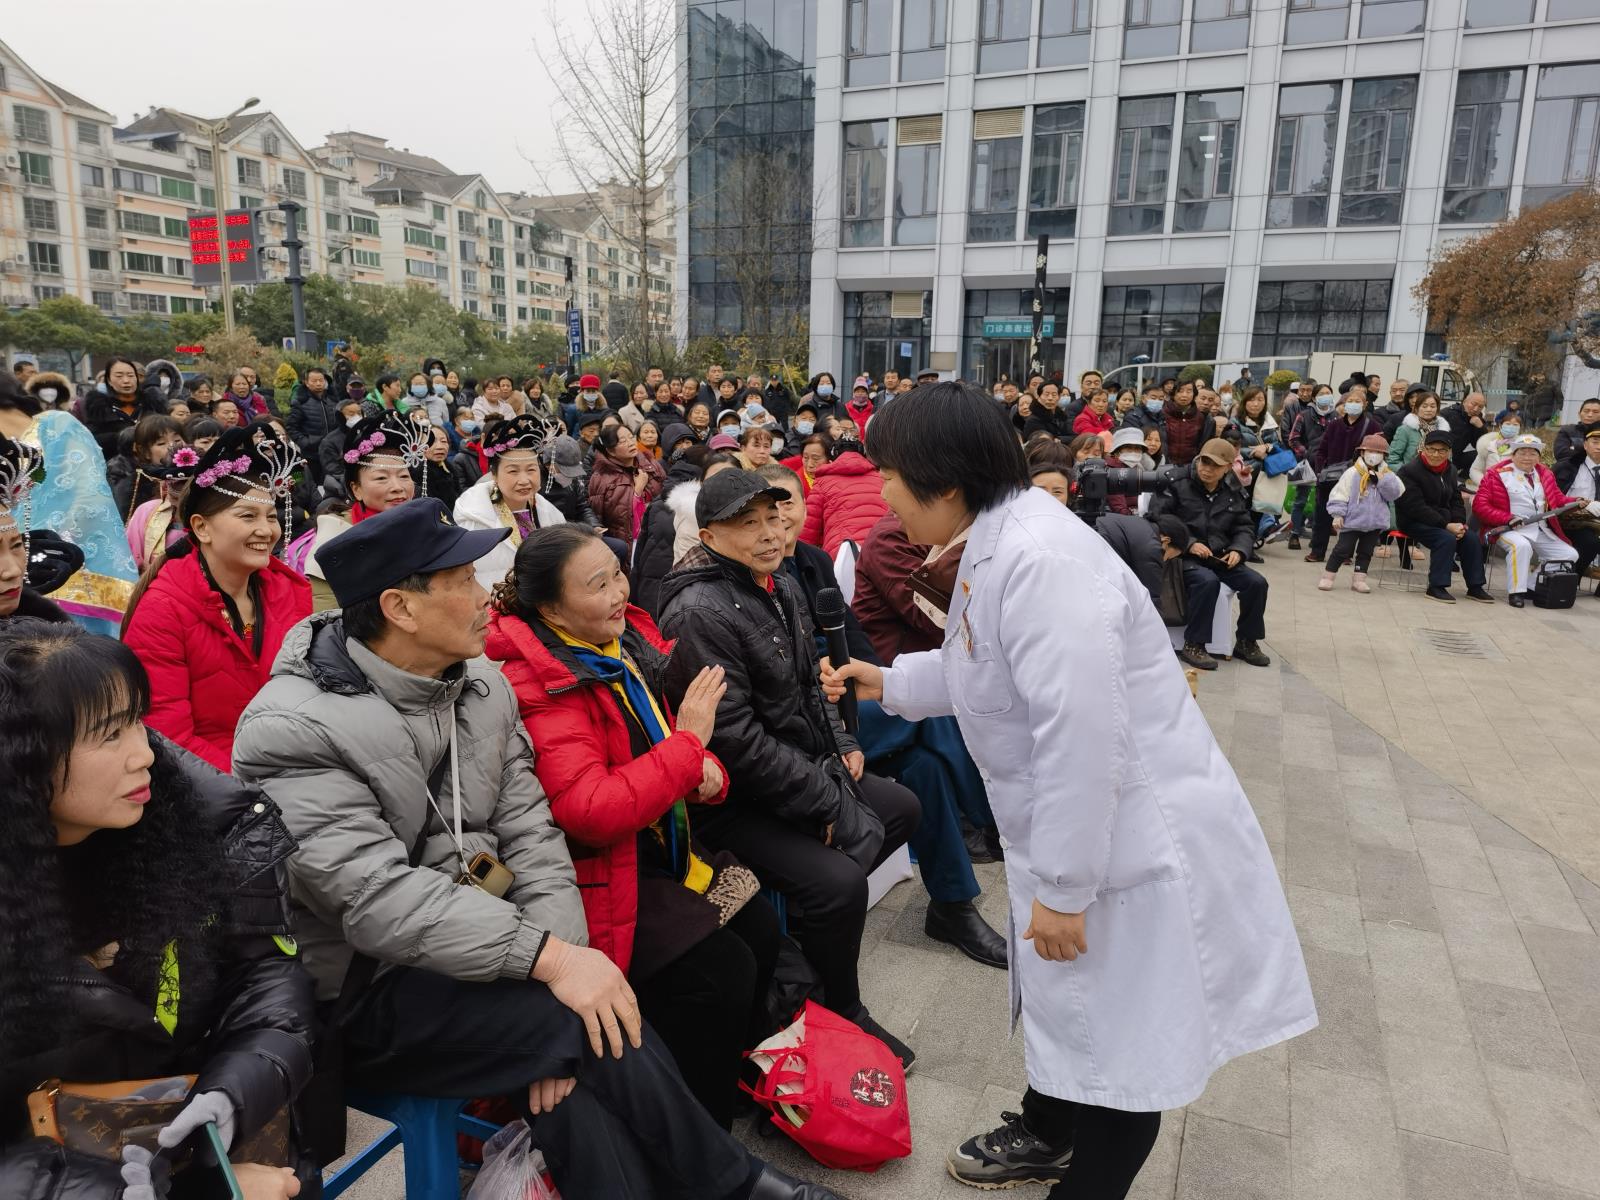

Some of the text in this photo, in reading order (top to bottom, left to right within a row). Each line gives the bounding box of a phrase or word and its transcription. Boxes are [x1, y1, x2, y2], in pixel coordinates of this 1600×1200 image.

[986, 324, 1051, 333] 门诊患者出口
